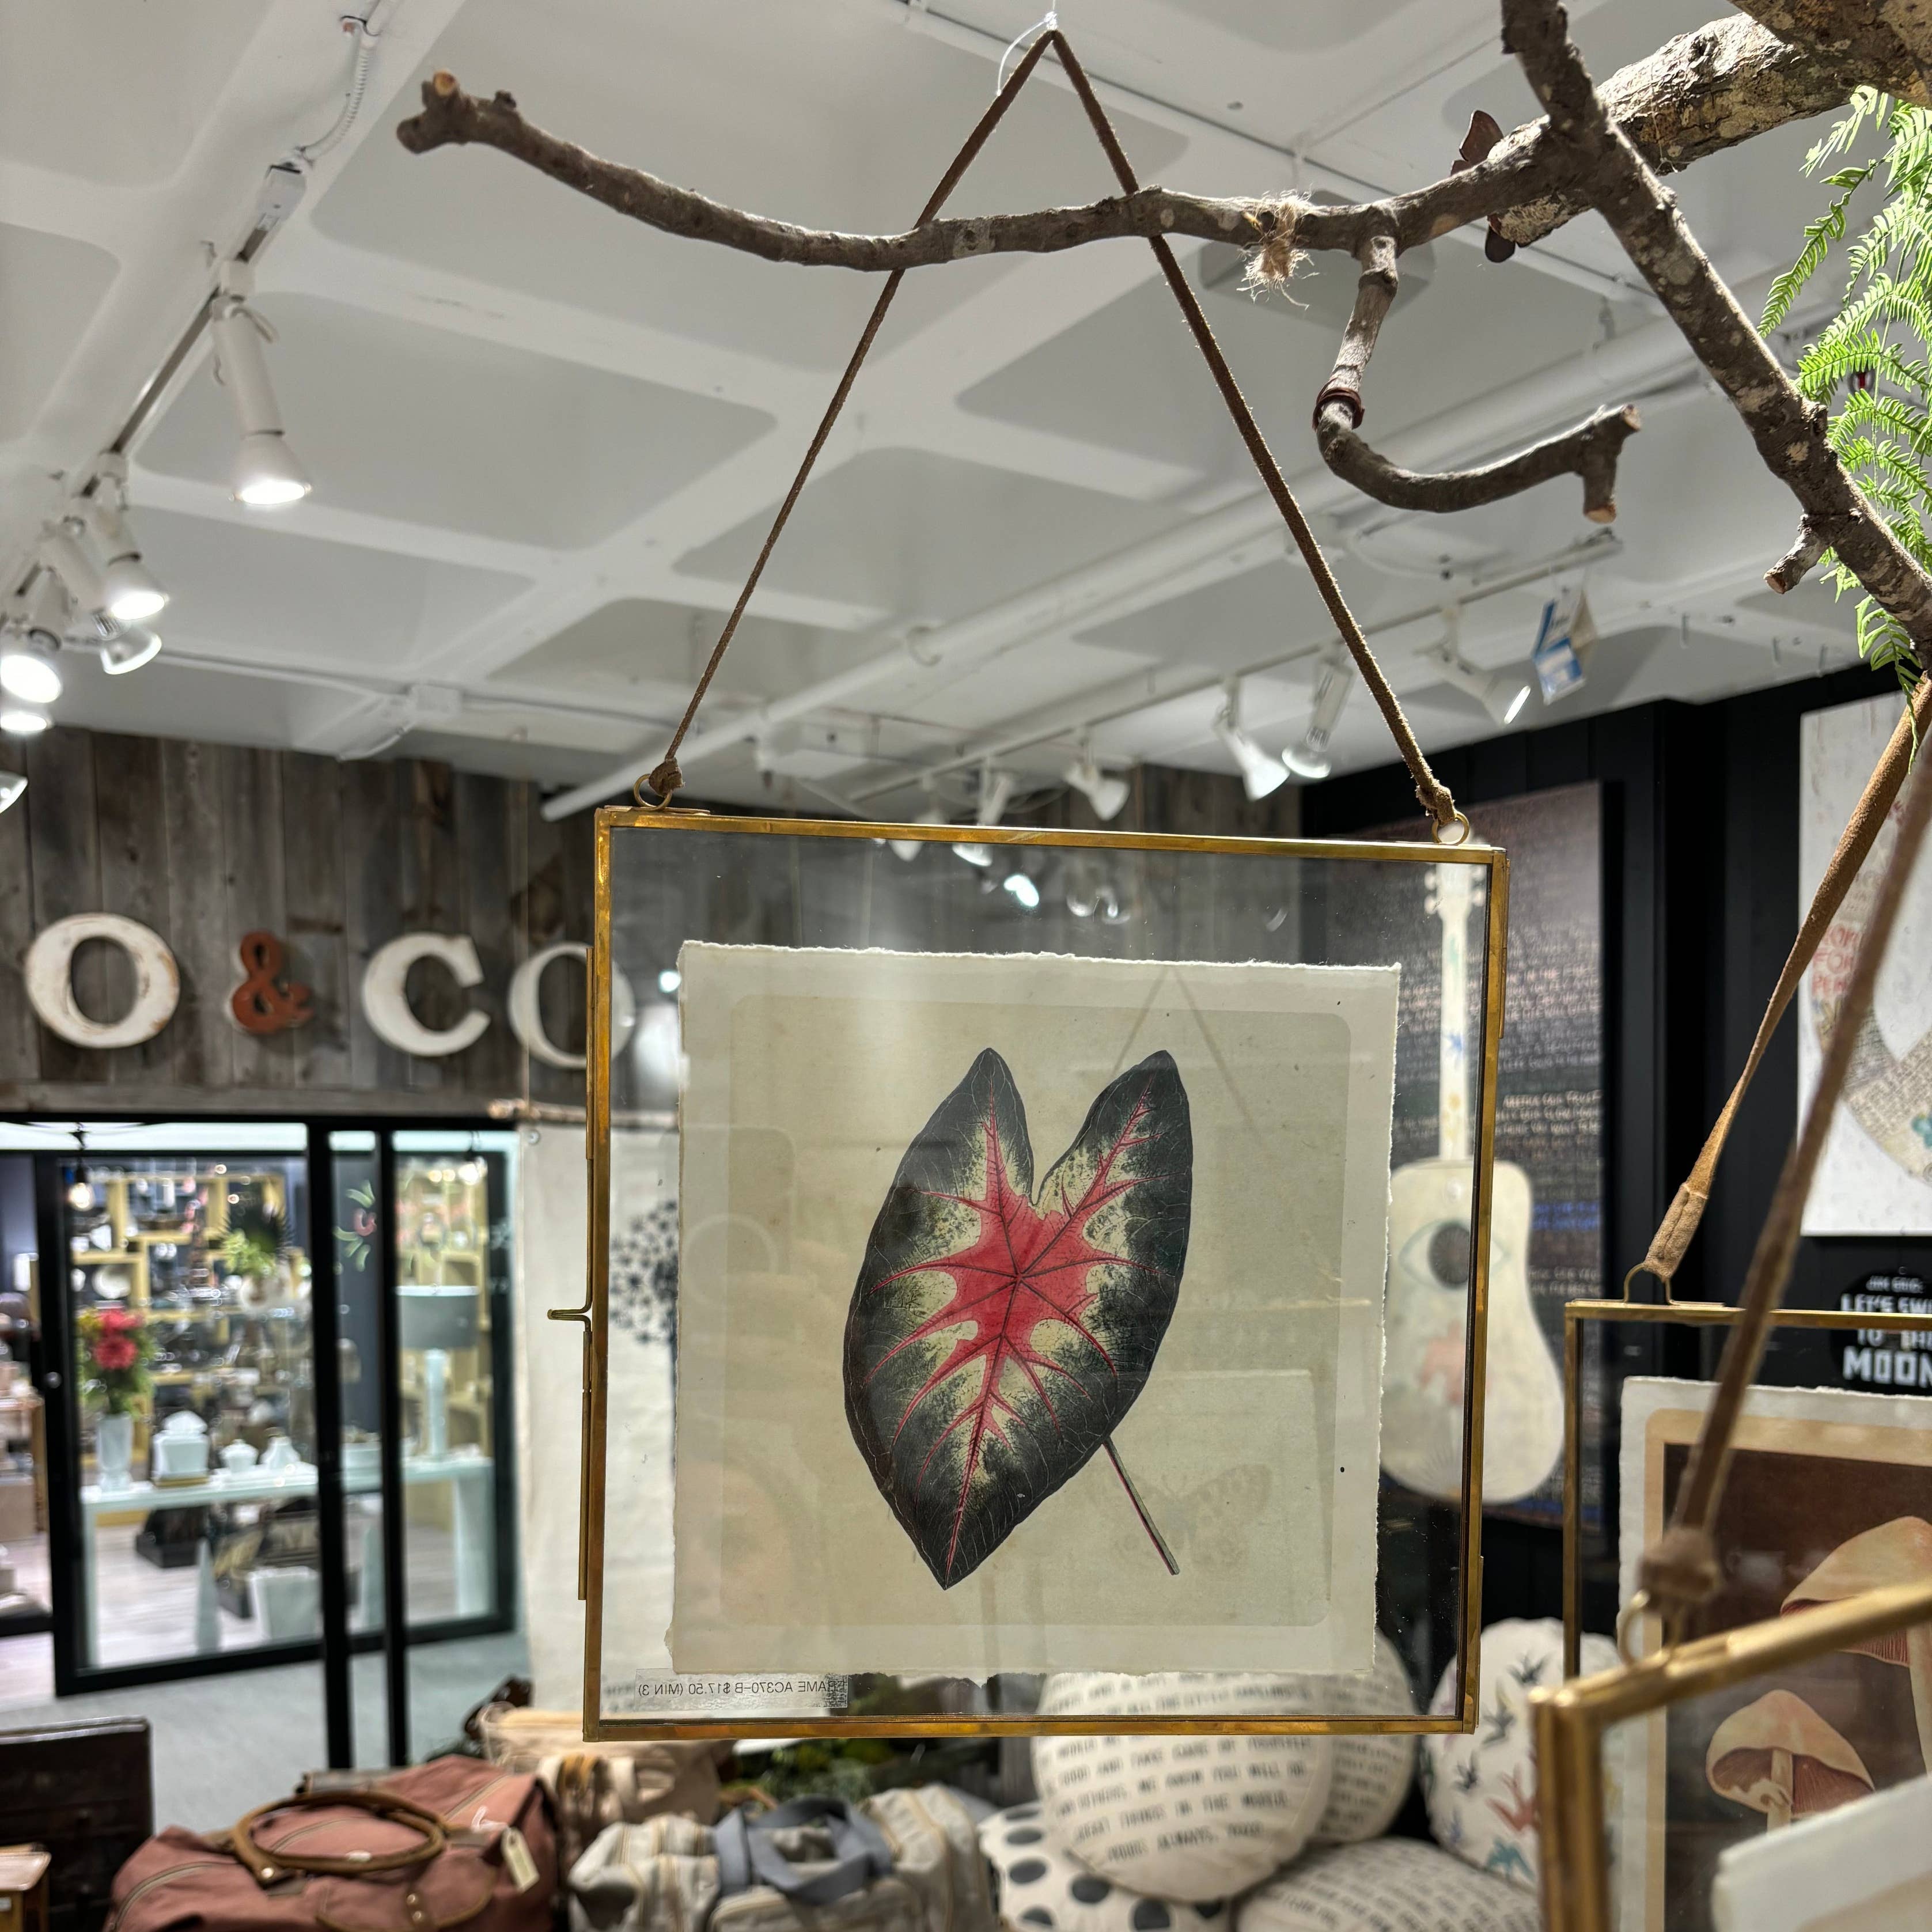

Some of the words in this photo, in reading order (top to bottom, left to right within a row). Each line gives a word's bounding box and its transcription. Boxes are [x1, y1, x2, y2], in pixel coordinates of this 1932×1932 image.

[25, 912, 180, 1049] O
[231, 929, 315, 1036] &
[362, 931, 635, 1069] CO
